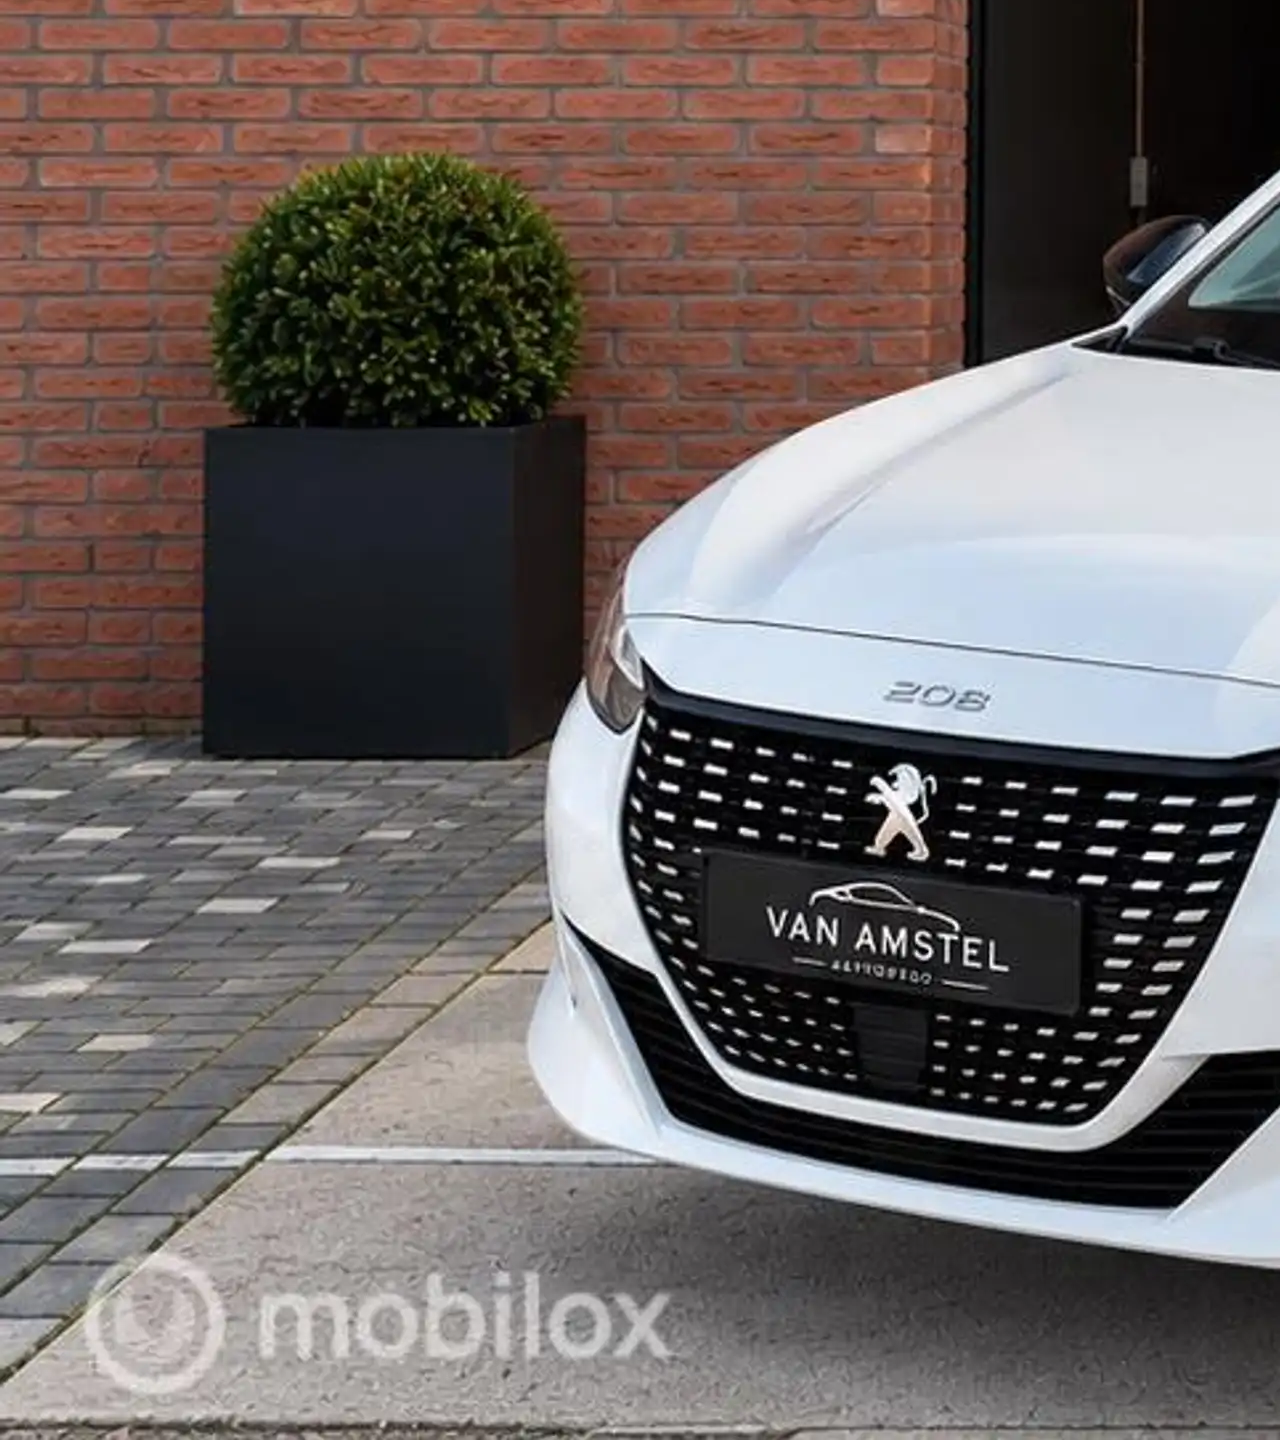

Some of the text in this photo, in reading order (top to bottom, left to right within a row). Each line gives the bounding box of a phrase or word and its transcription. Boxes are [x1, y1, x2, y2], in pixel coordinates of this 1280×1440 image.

[883, 681, 991, 712] 208
[765, 906, 840, 947] VAN
[854, 921, 1010, 973] AMSTEL
